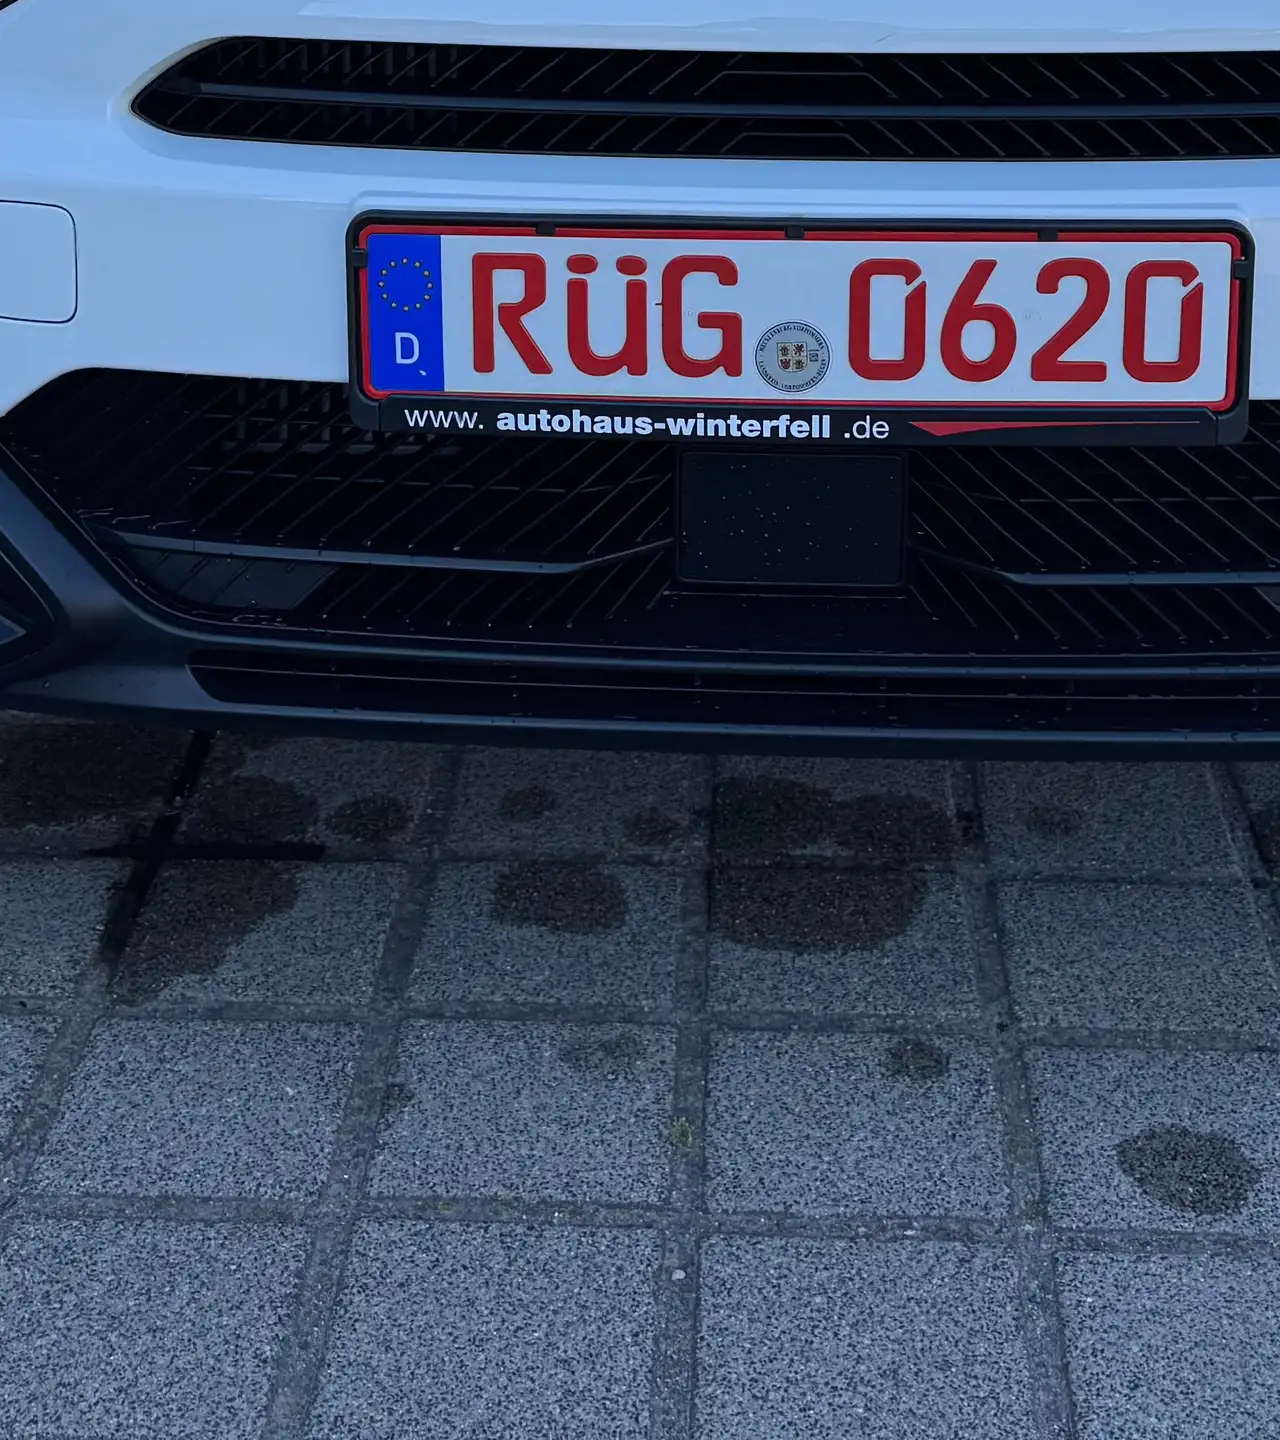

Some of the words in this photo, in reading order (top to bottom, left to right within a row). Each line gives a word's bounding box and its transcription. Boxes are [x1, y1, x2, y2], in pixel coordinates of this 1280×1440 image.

[471, 252, 743, 379] RÜG
[848, 257, 1204, 384] 0620
[394, 331, 420, 365] D
[403, 408, 485, 430] www.
[496, 408, 832, 440] autohaus-winterfell
[843, 414, 890, 440] .de
